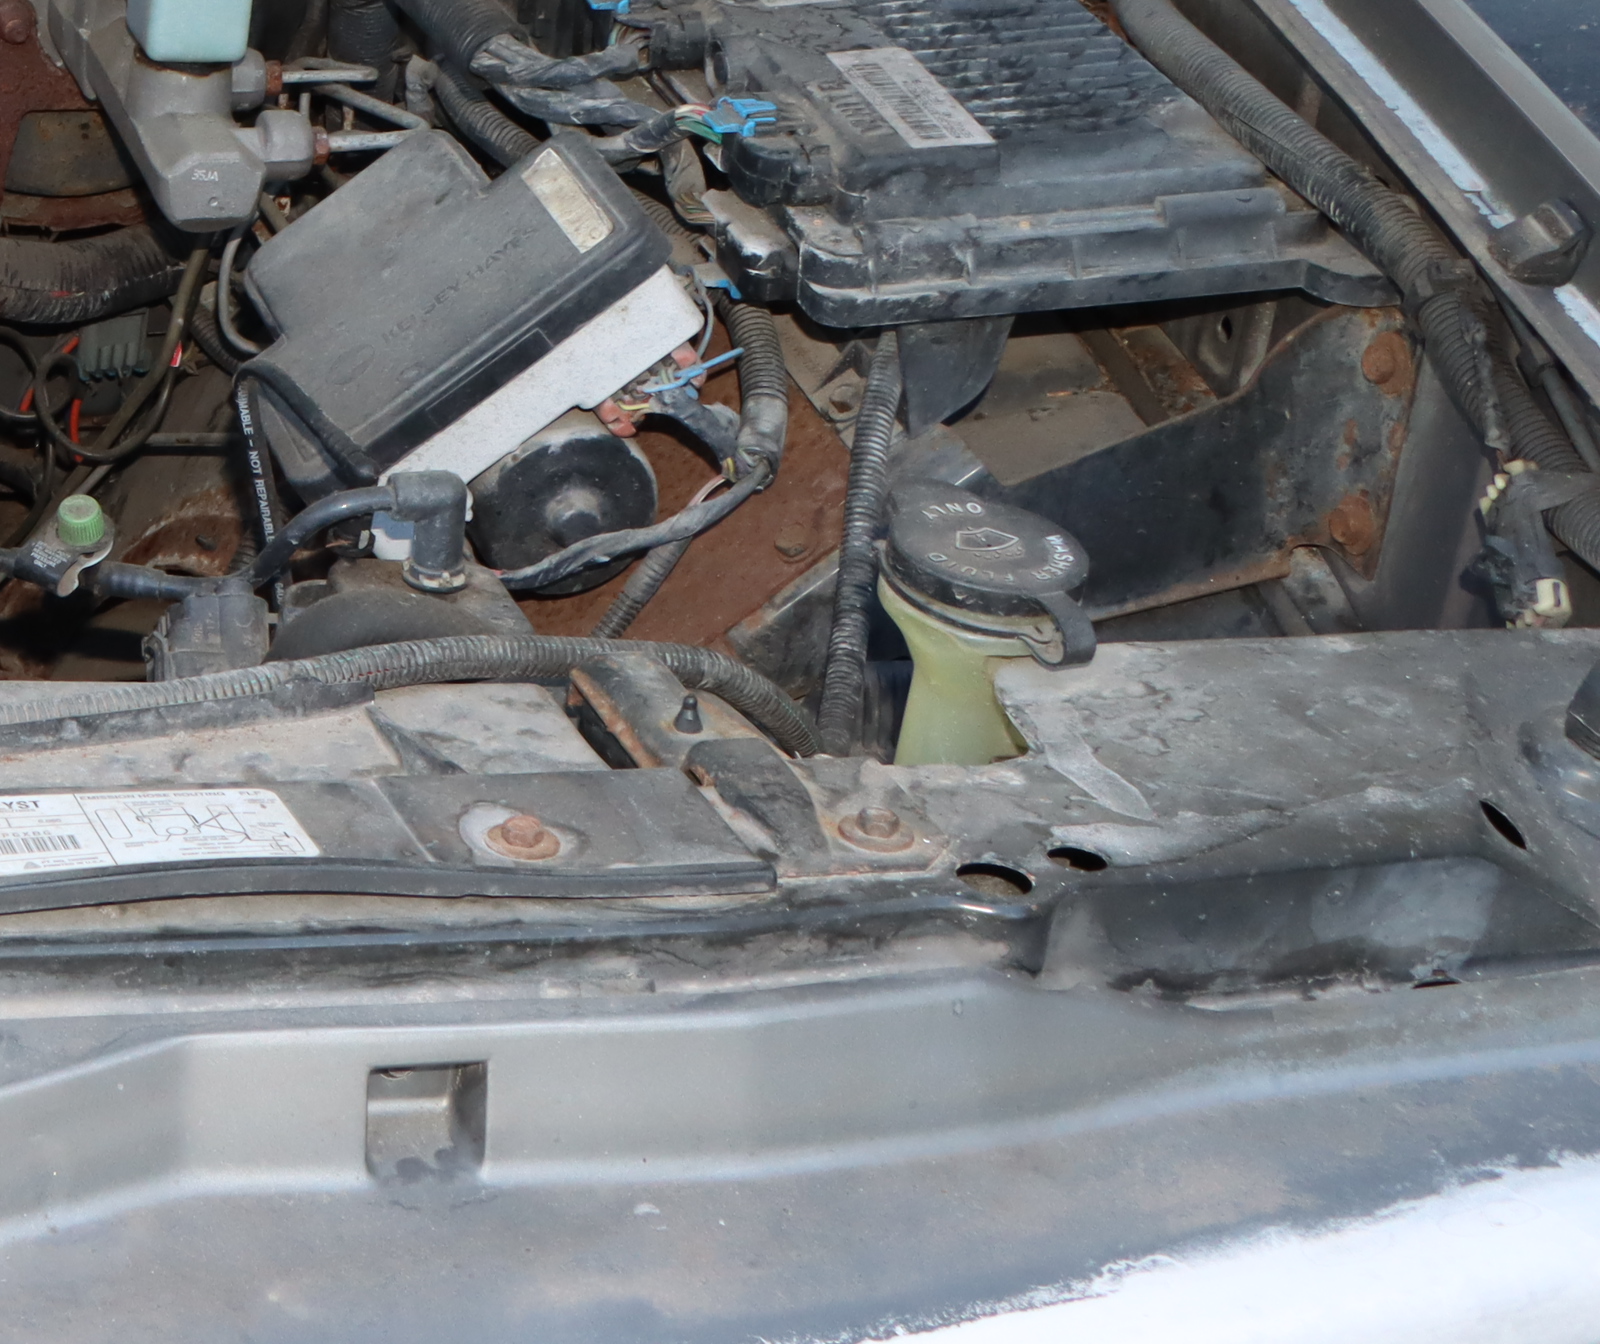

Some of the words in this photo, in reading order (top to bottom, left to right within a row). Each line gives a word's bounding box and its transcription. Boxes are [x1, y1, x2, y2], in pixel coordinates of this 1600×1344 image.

[248, 451, 262, 475] NOT
[922, 502, 983, 520] ONLY
[926, 552, 1015, 584] FLUID
[1031, 534, 1075, 581] WASHER
